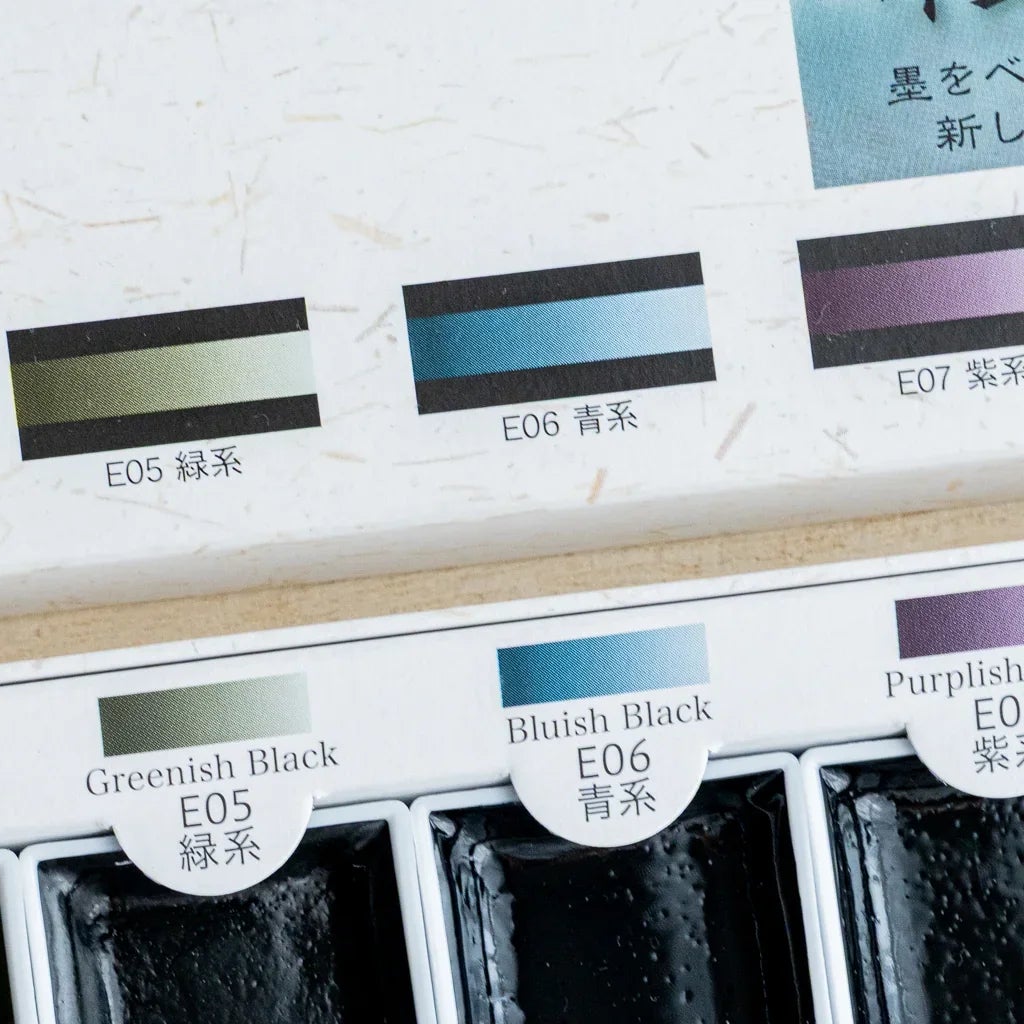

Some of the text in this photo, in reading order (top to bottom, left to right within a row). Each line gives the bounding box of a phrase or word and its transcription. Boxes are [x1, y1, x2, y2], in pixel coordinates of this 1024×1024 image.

[936, 112, 1024, 152] 新し
[898, 366, 950, 395] E07
[503, 400, 638, 441] E06 青系
[106, 446, 242, 487] E05 緑系
[886, 658, 1024, 698] Purplish
[507, 695, 712, 744] Bluish Black
[86, 741, 338, 795] Greenish Black
[578, 738, 650, 779] E06
[973, 736, 1024, 773] 紫
[181, 789, 251, 828] E05
[578, 777, 655, 822] 青系
[179, 826, 260, 872] 緑系
